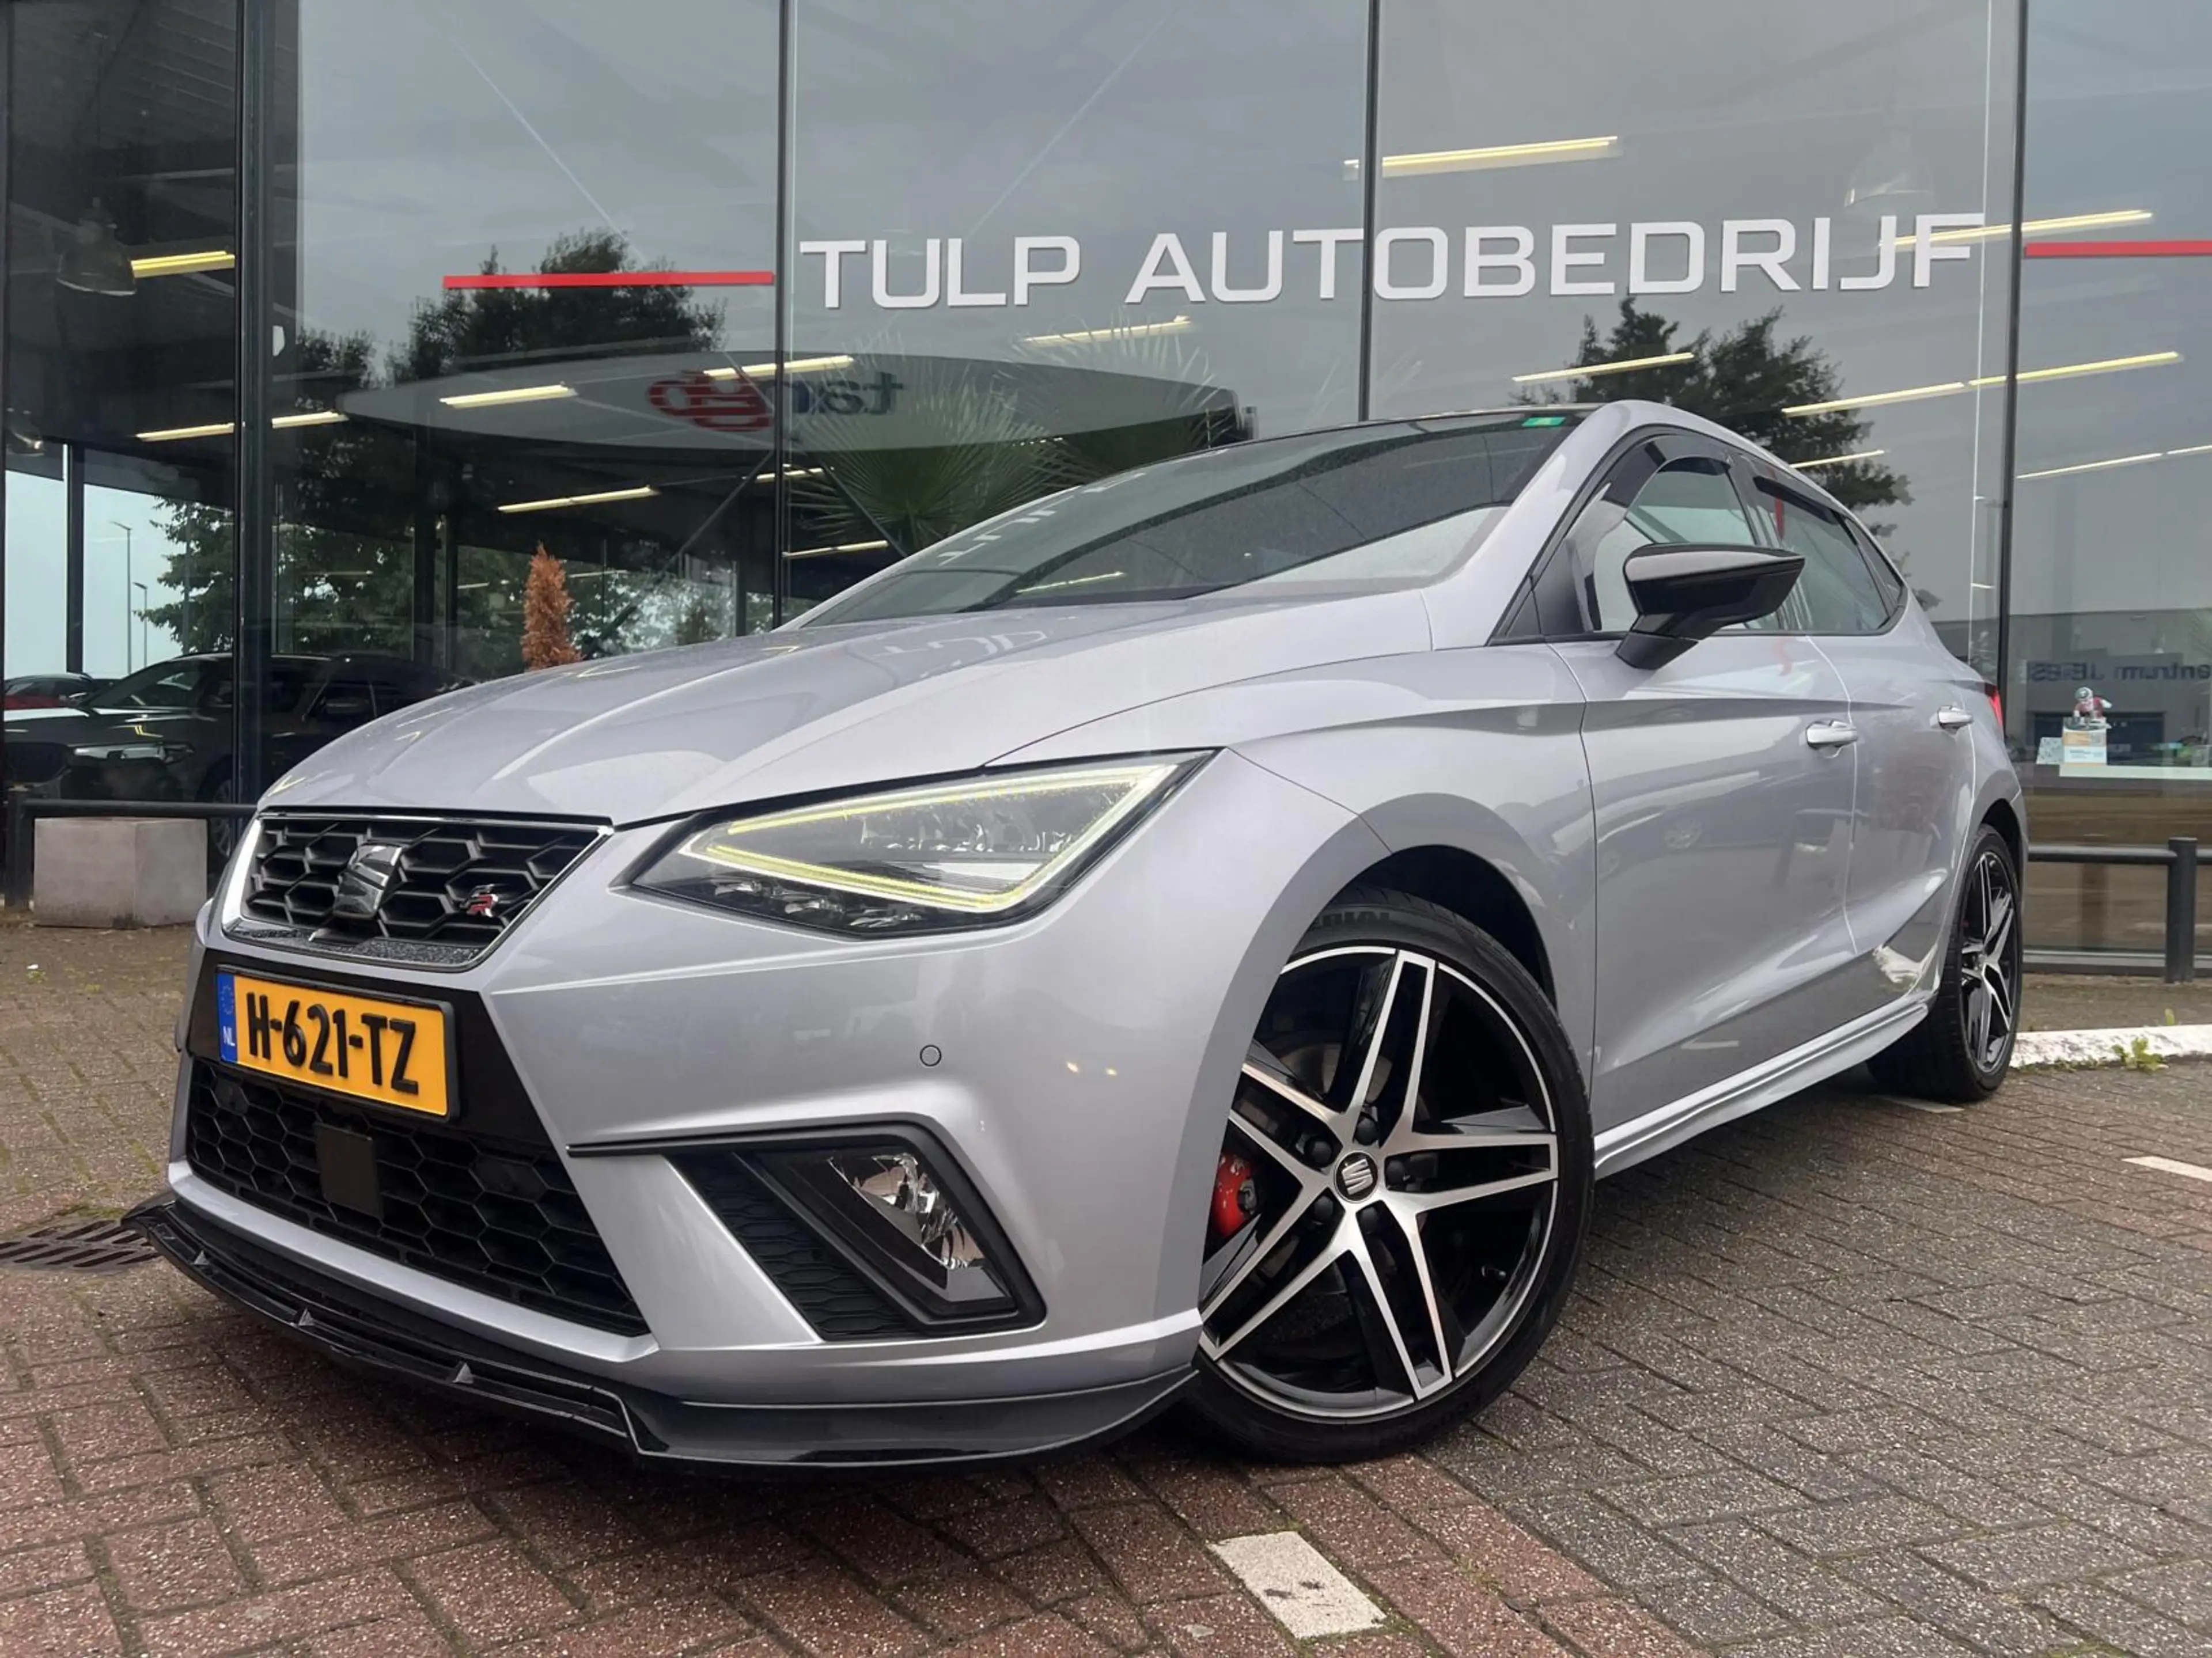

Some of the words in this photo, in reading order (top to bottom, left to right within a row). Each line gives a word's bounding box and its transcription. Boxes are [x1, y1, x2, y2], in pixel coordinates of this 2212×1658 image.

[800, 237, 1080, 308] TULP
[1125, 213, 1986, 303] AUTOBEDRIJF
[223, 1025, 236, 1046] NL
[246, 992, 419, 1095] H-621-TZ
